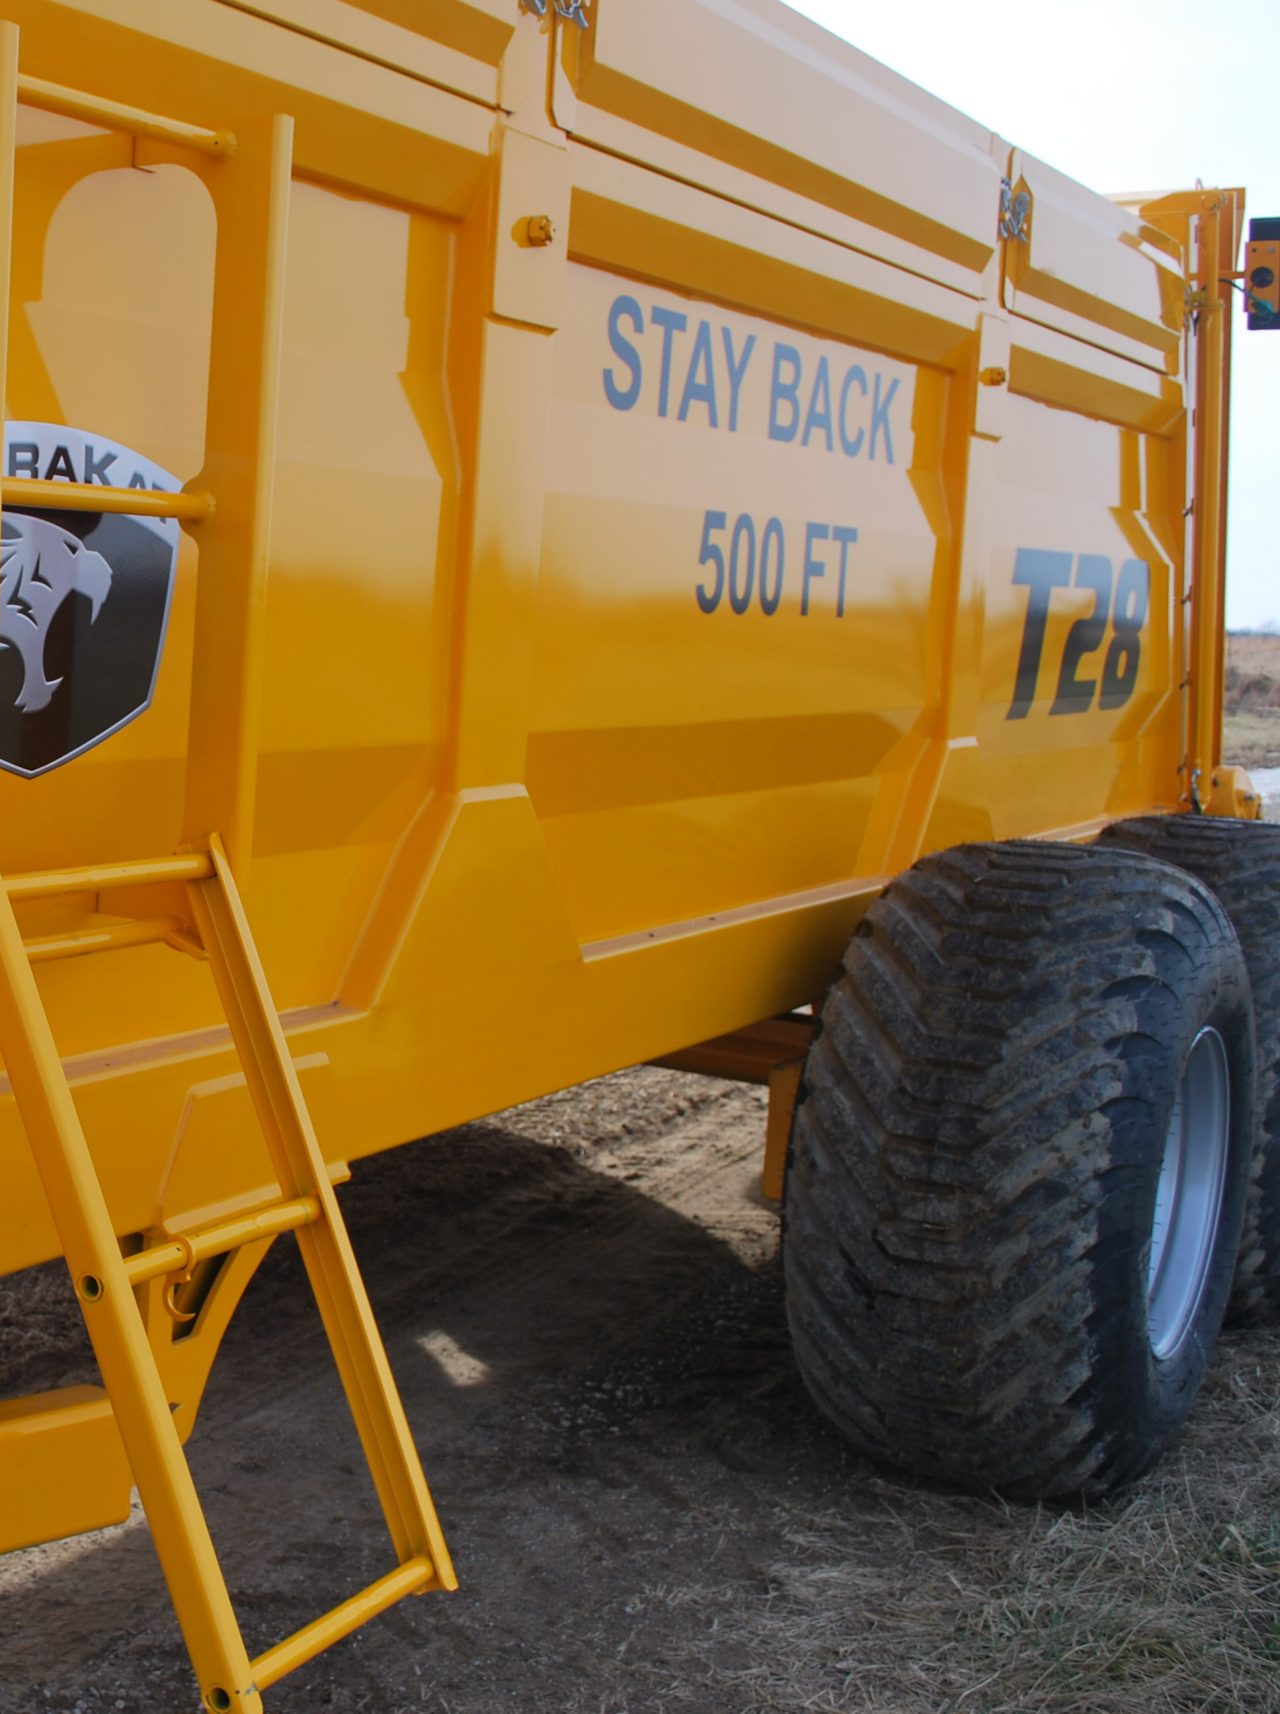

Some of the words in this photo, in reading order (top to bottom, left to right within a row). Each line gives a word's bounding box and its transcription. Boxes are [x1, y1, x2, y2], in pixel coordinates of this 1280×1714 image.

[602, 295, 756, 432] STAY
[768, 341, 901, 465] BACK
[696, 509, 785, 616] 500
[800, 521, 858, 618] FT
[1005, 547, 1150, 720] T28
